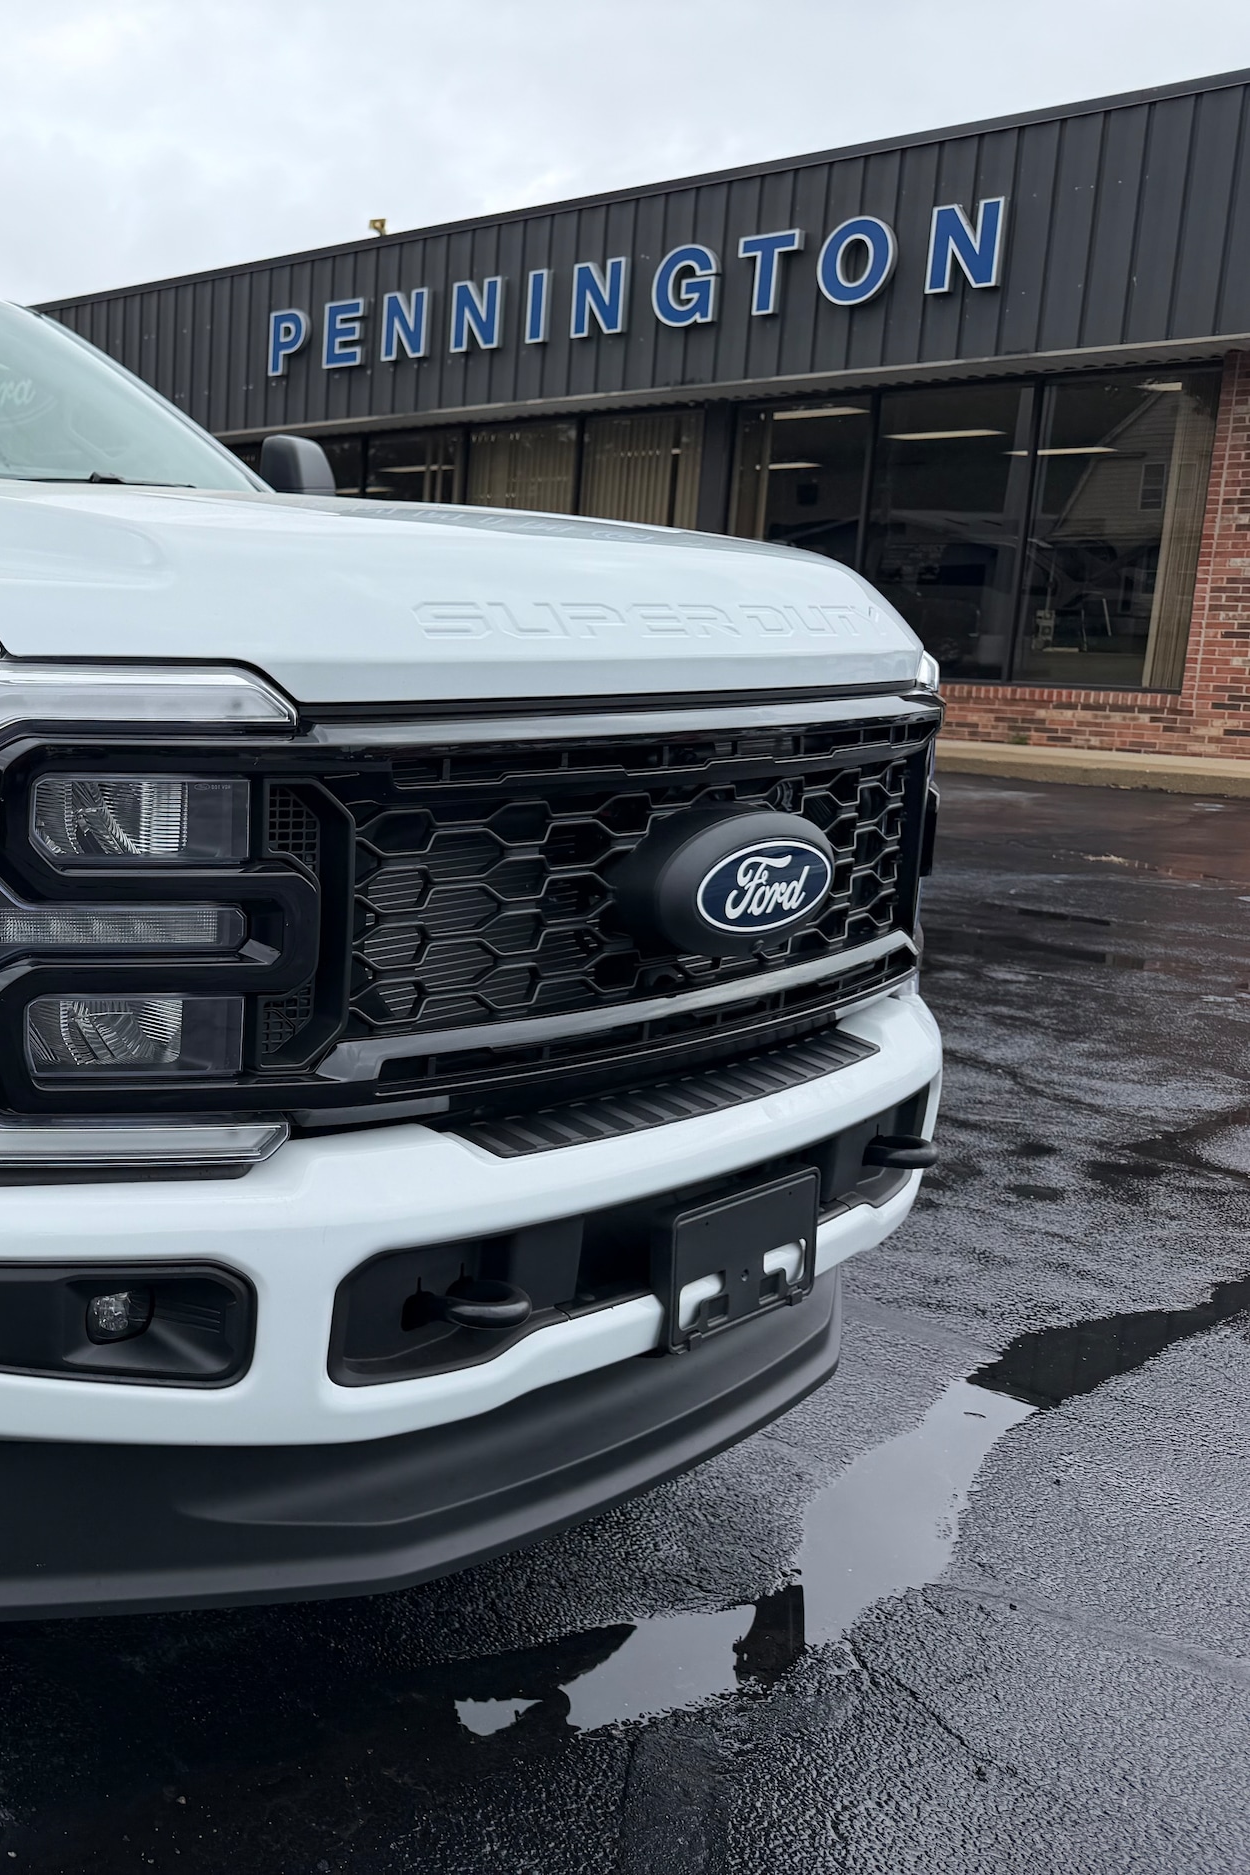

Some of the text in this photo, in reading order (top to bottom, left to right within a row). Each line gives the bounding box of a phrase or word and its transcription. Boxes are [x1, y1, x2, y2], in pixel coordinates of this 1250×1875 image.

[266, 196, 1006, 377] PENNINGTON
[412, 601, 888, 640] SUPER DUTY
[724, 854, 811, 920] Ford
